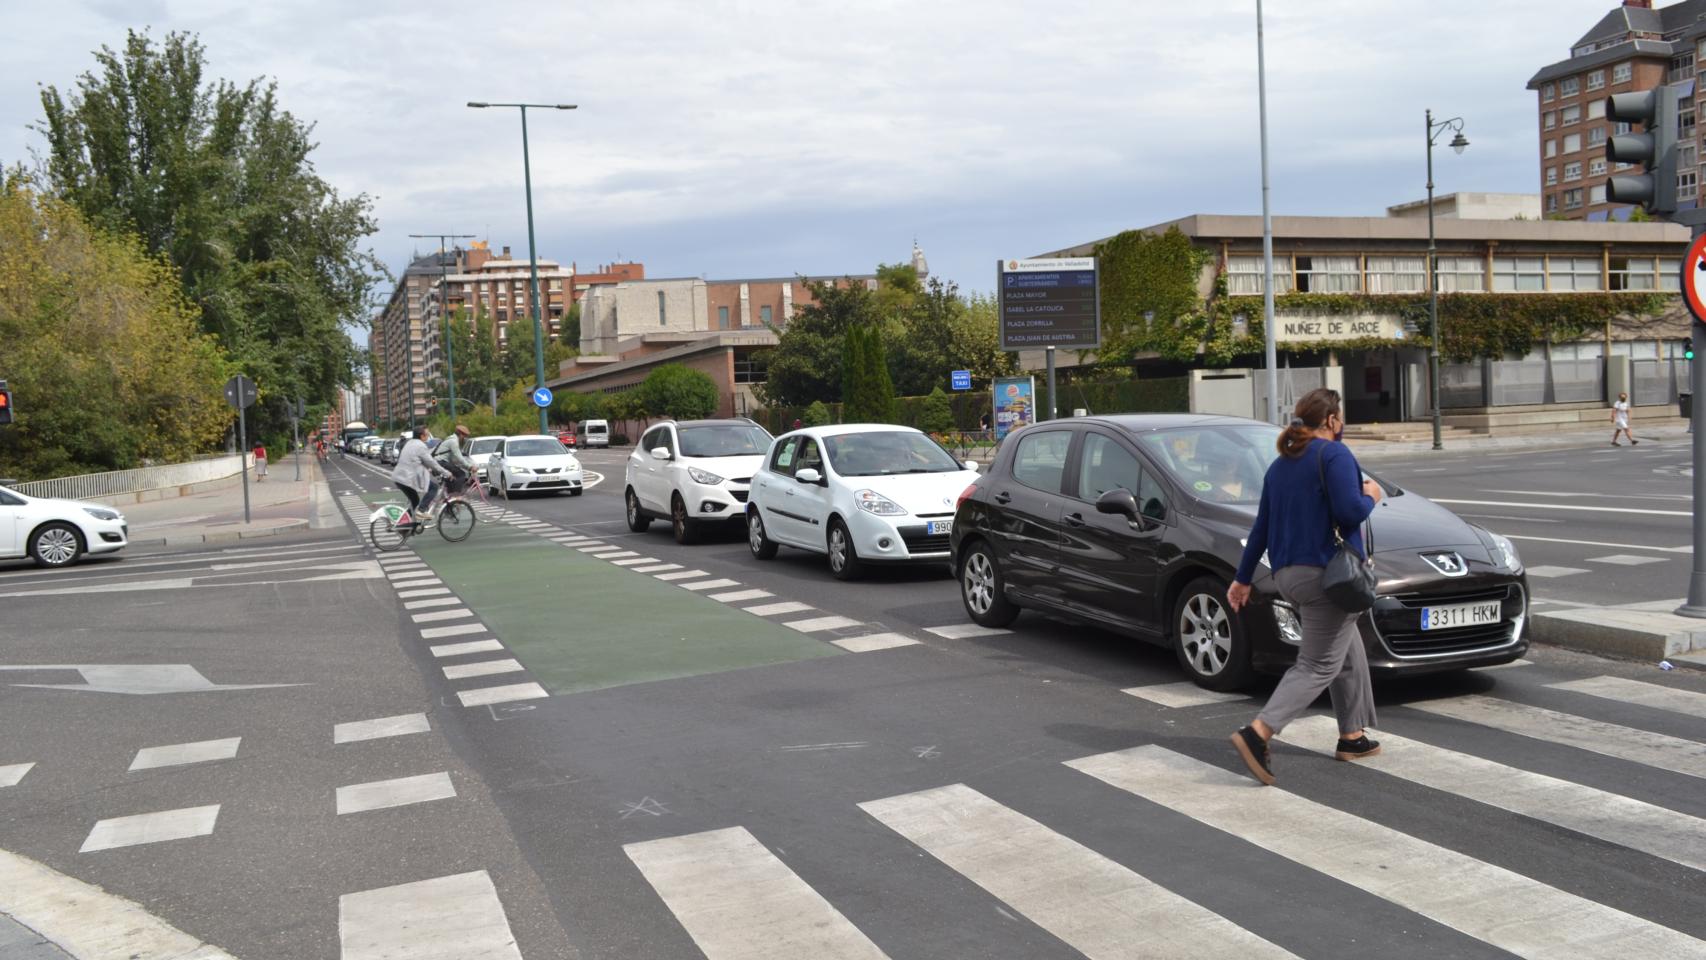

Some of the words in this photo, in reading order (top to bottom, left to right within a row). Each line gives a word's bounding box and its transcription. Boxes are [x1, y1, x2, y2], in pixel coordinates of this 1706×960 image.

[1328, 322, 1343, 334] DE
[1350, 321, 1380, 333] ARCE
[1432, 607, 1465, 626] 3311
[1472, 604, 1498, 622] HKM
